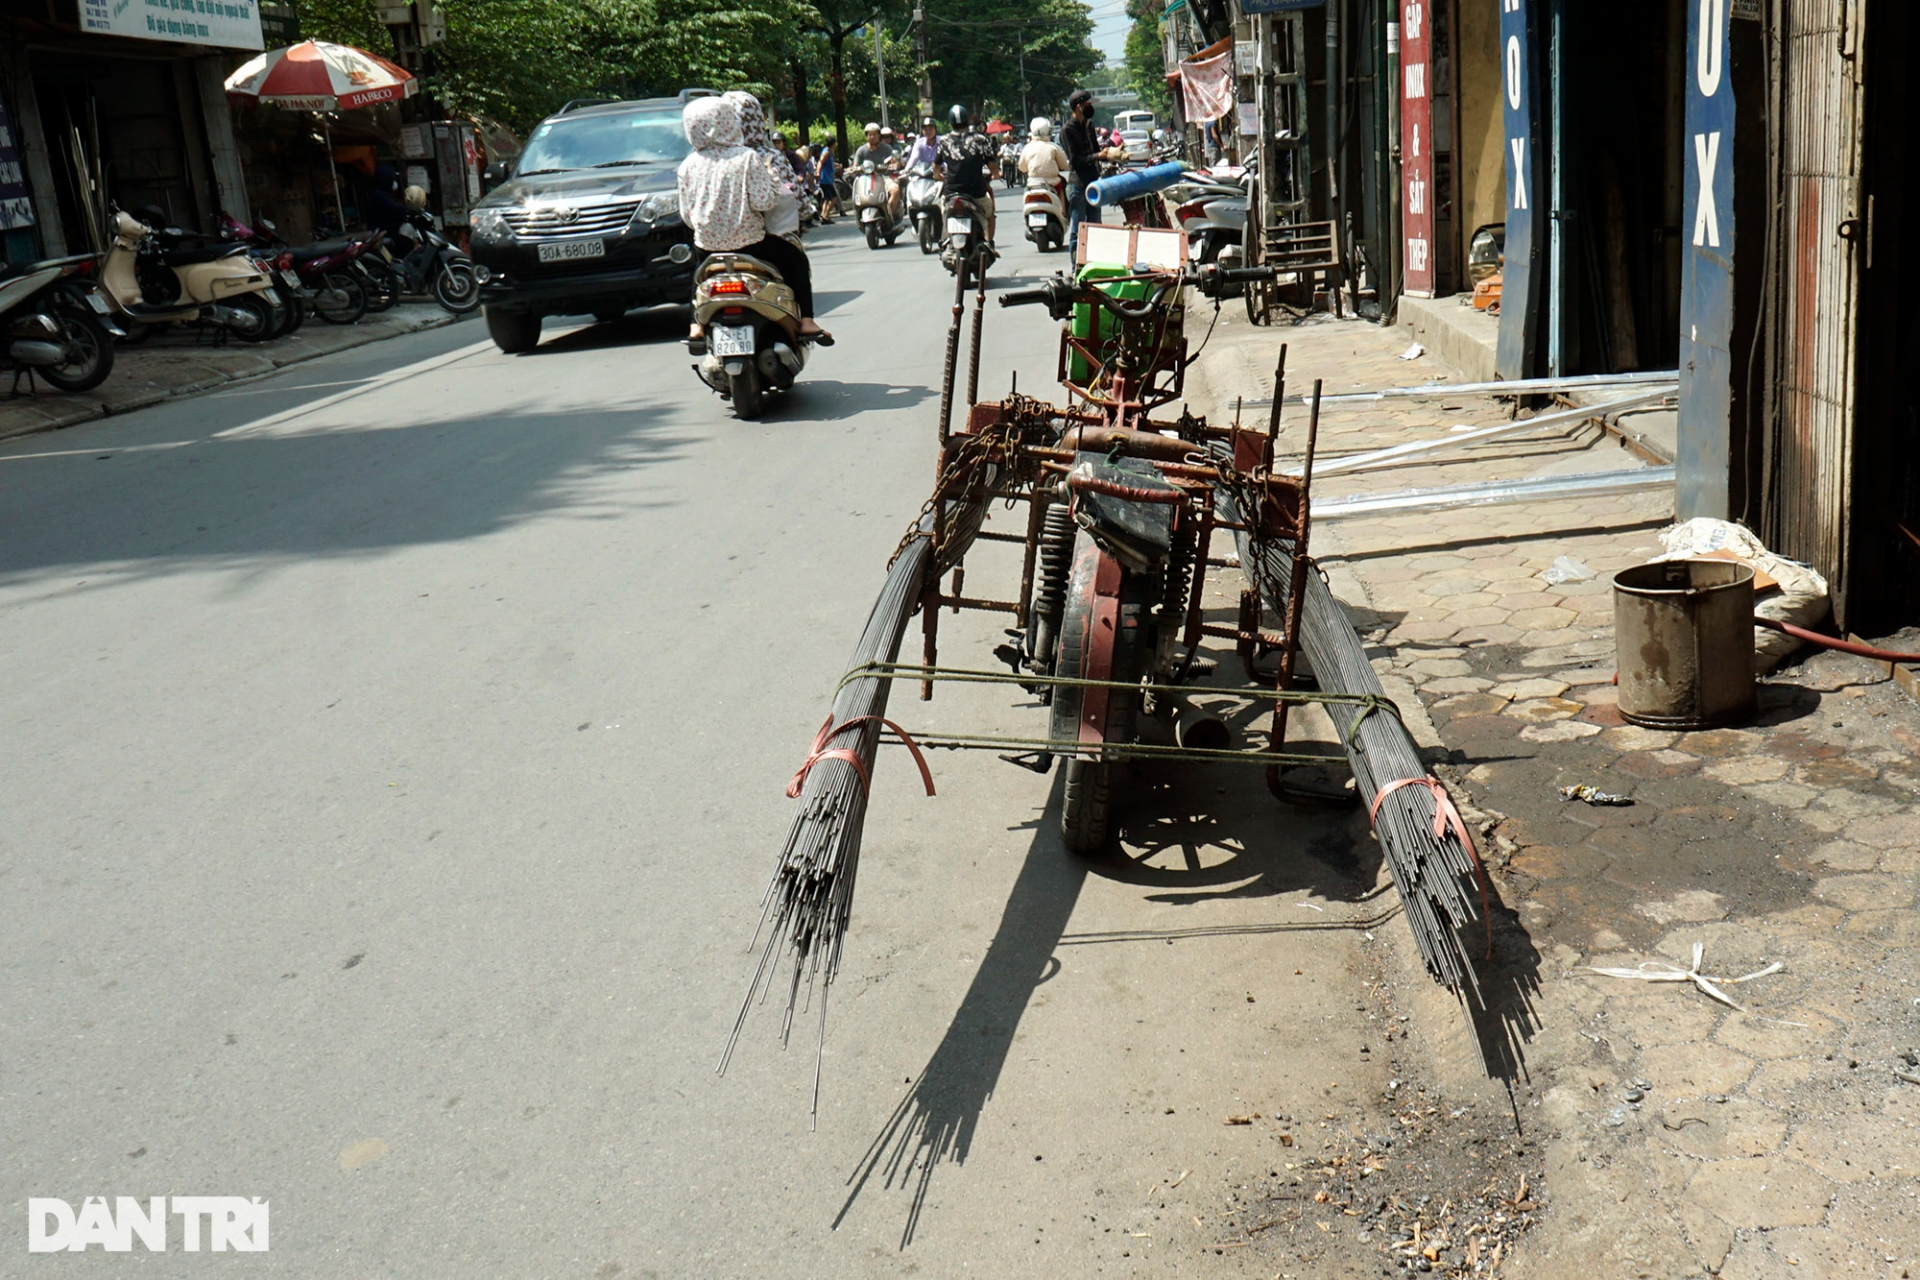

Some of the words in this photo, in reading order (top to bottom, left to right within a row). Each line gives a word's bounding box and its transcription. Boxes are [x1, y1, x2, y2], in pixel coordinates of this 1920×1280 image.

[352, 88, 393, 105] HABECO
[1405, 63, 1425, 99] INOX
[1412, 123, 1420, 157] &
[1408, 232, 1428, 271] THÉP
